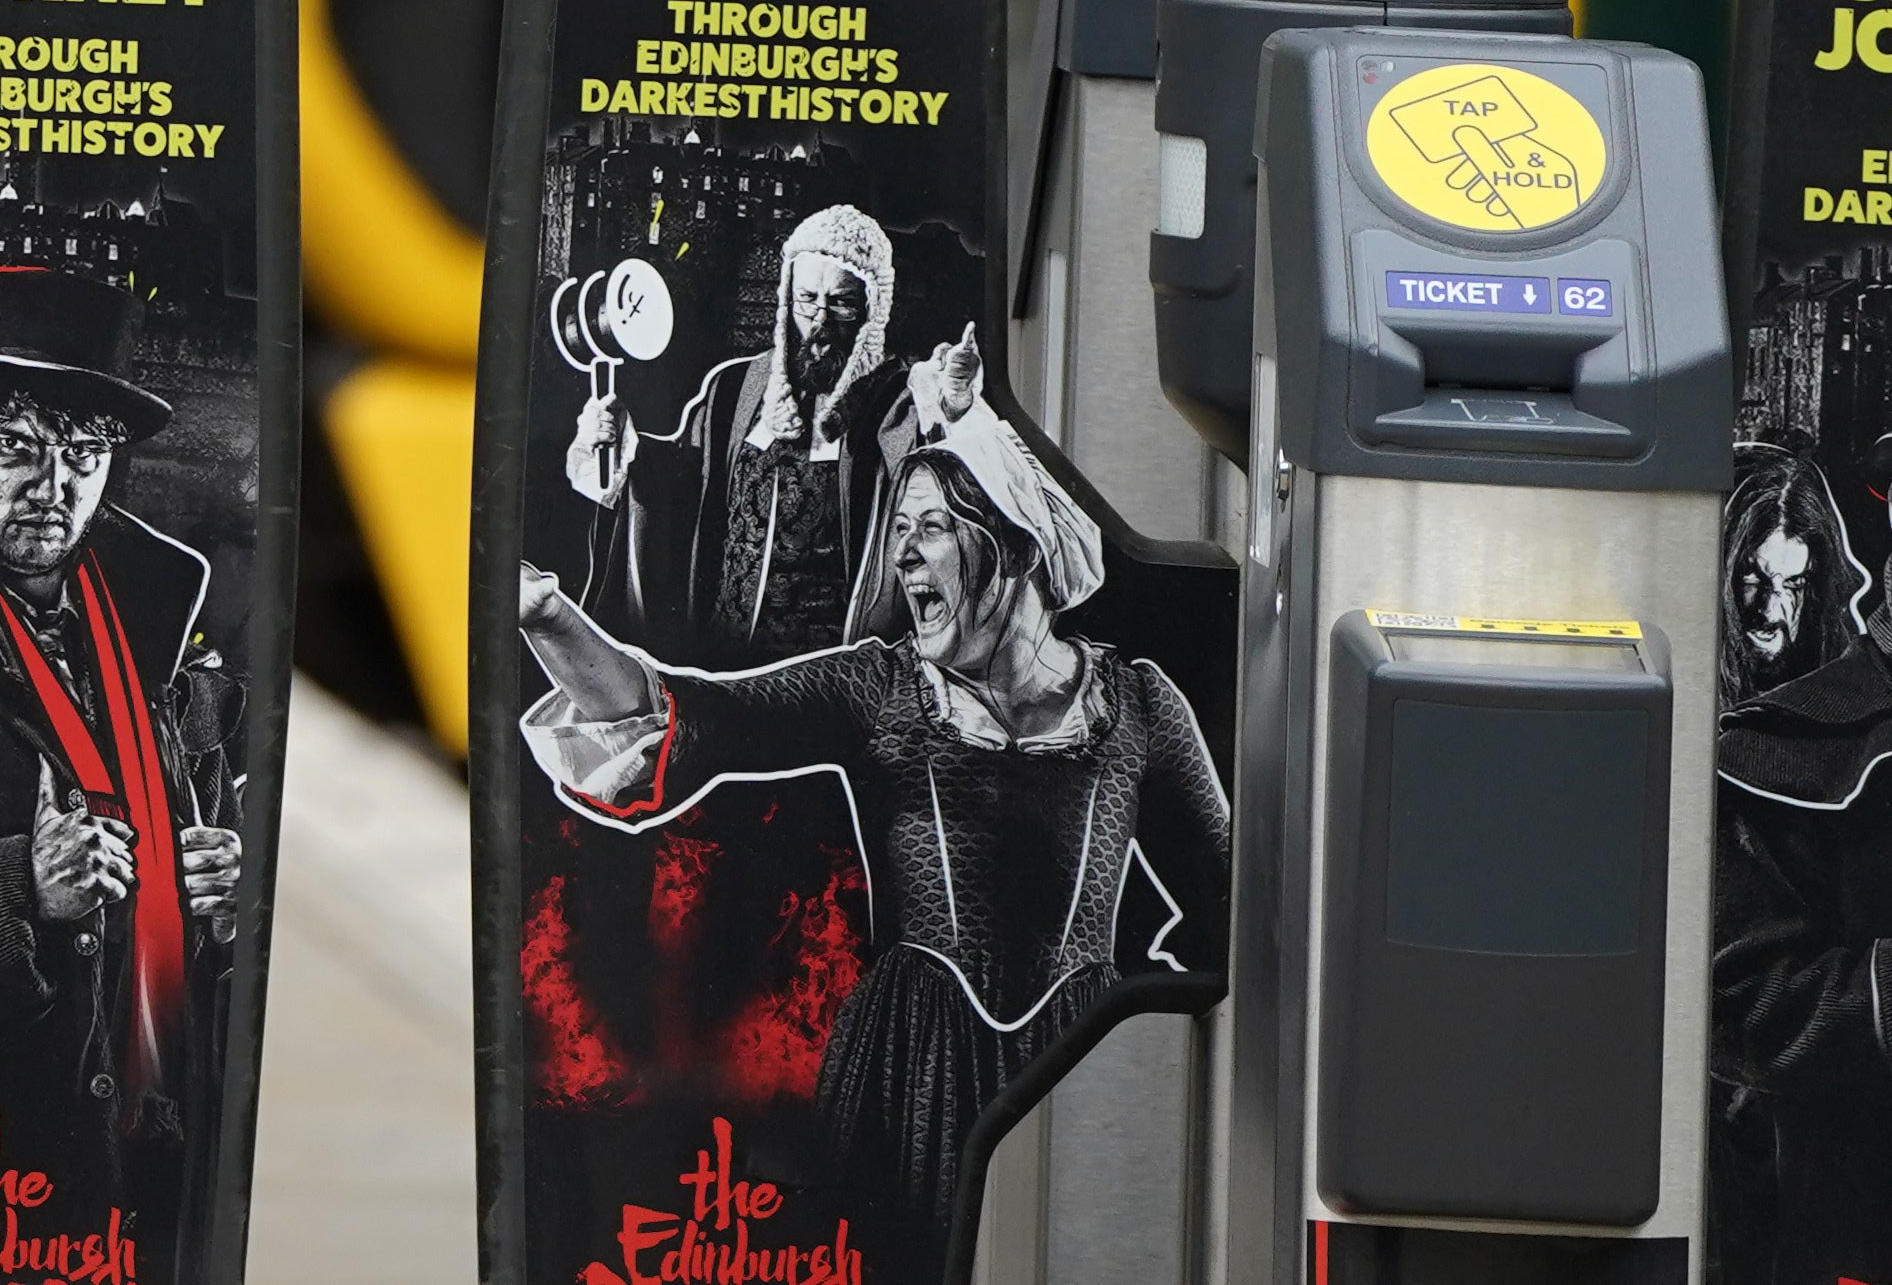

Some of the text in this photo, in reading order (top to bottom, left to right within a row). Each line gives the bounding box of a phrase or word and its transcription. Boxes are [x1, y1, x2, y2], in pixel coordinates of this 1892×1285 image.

[670, 1, 866, 40] THROUGH
[637, 40, 898, 83] EDINBURGH'S
[1443, 99, 1498, 118] TAP
[1526, 151, 1546, 168] &
[1493, 170, 1573, 191] HOLD
[1400, 279, 1606, 311] TICKET 62
[680, 1117, 783, 1230] the
